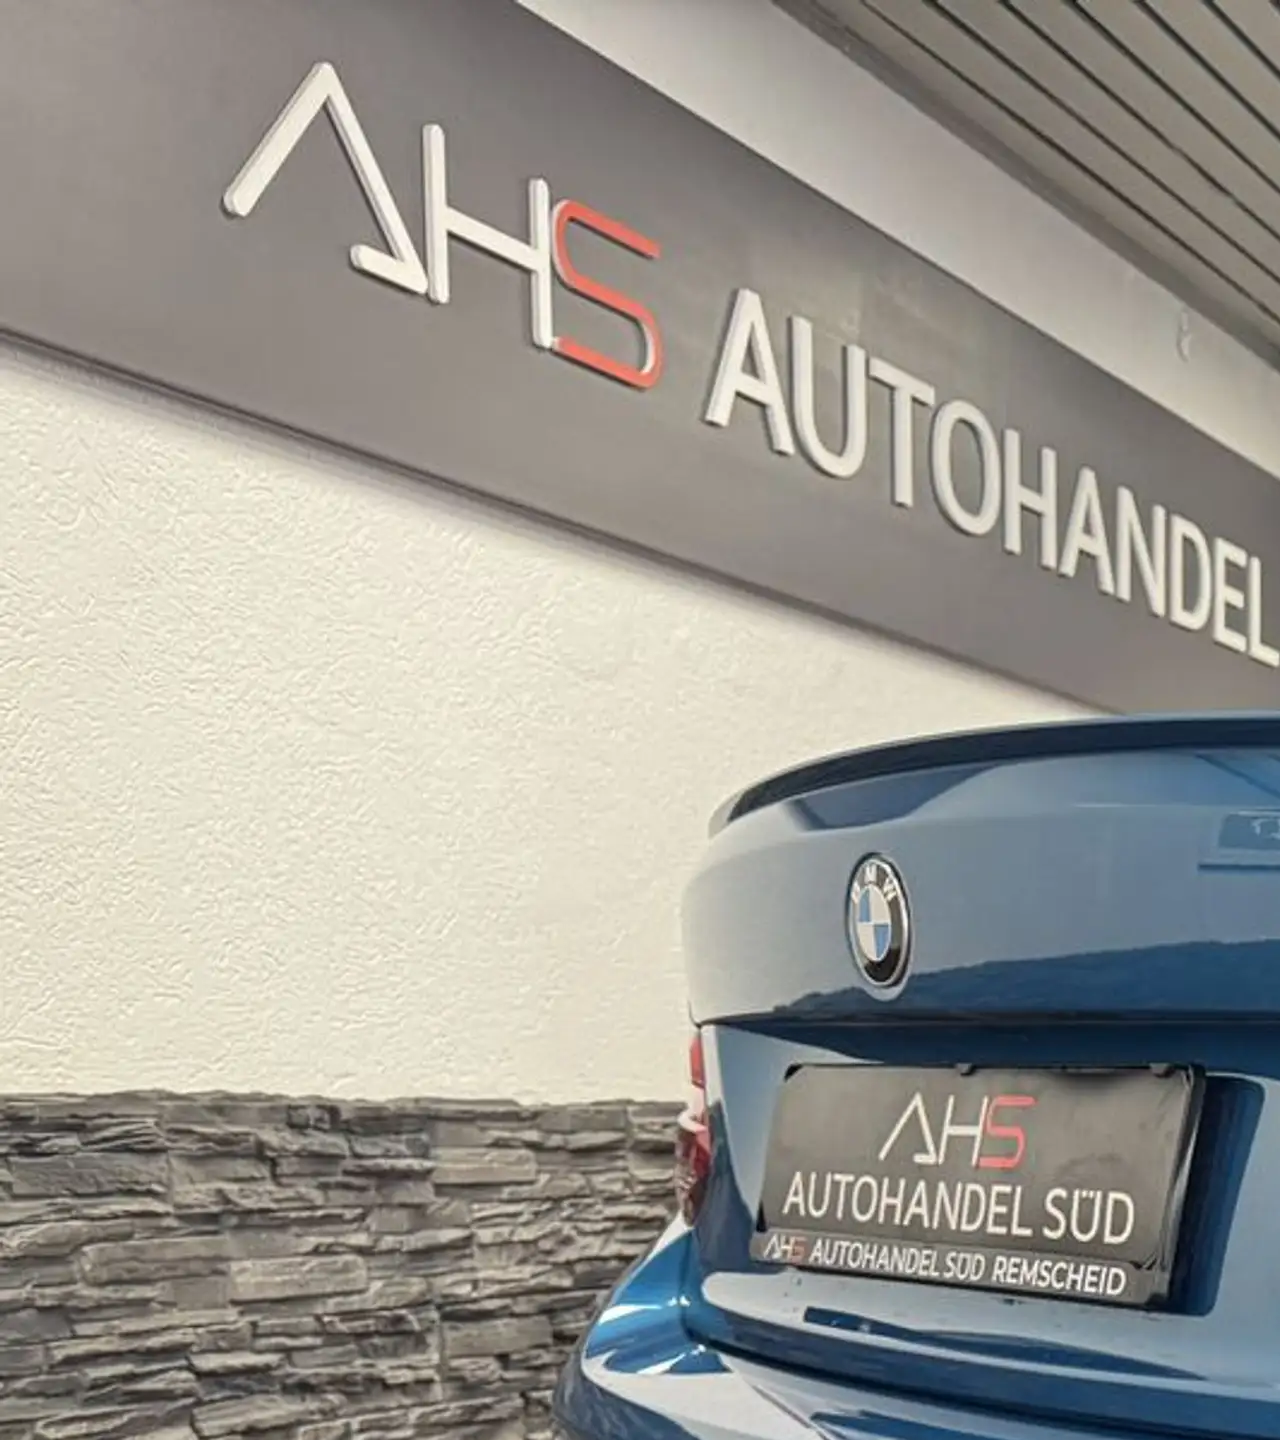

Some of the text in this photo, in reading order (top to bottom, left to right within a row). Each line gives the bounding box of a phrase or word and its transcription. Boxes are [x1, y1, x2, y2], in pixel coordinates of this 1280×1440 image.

[222, 60, 663, 391] AHS
[703, 287, 1280, 668] AUTOHANDEL
[878, 1091, 1038, 1169] AHS
[782, 1170, 1136, 1246] AUTOHANDEL SÜD
[762, 1233, 808, 1263] AHS
[808, 1238, 940, 1277] AUTOHANDEL
[991, 1255, 1127, 1296] REMSCHEID
